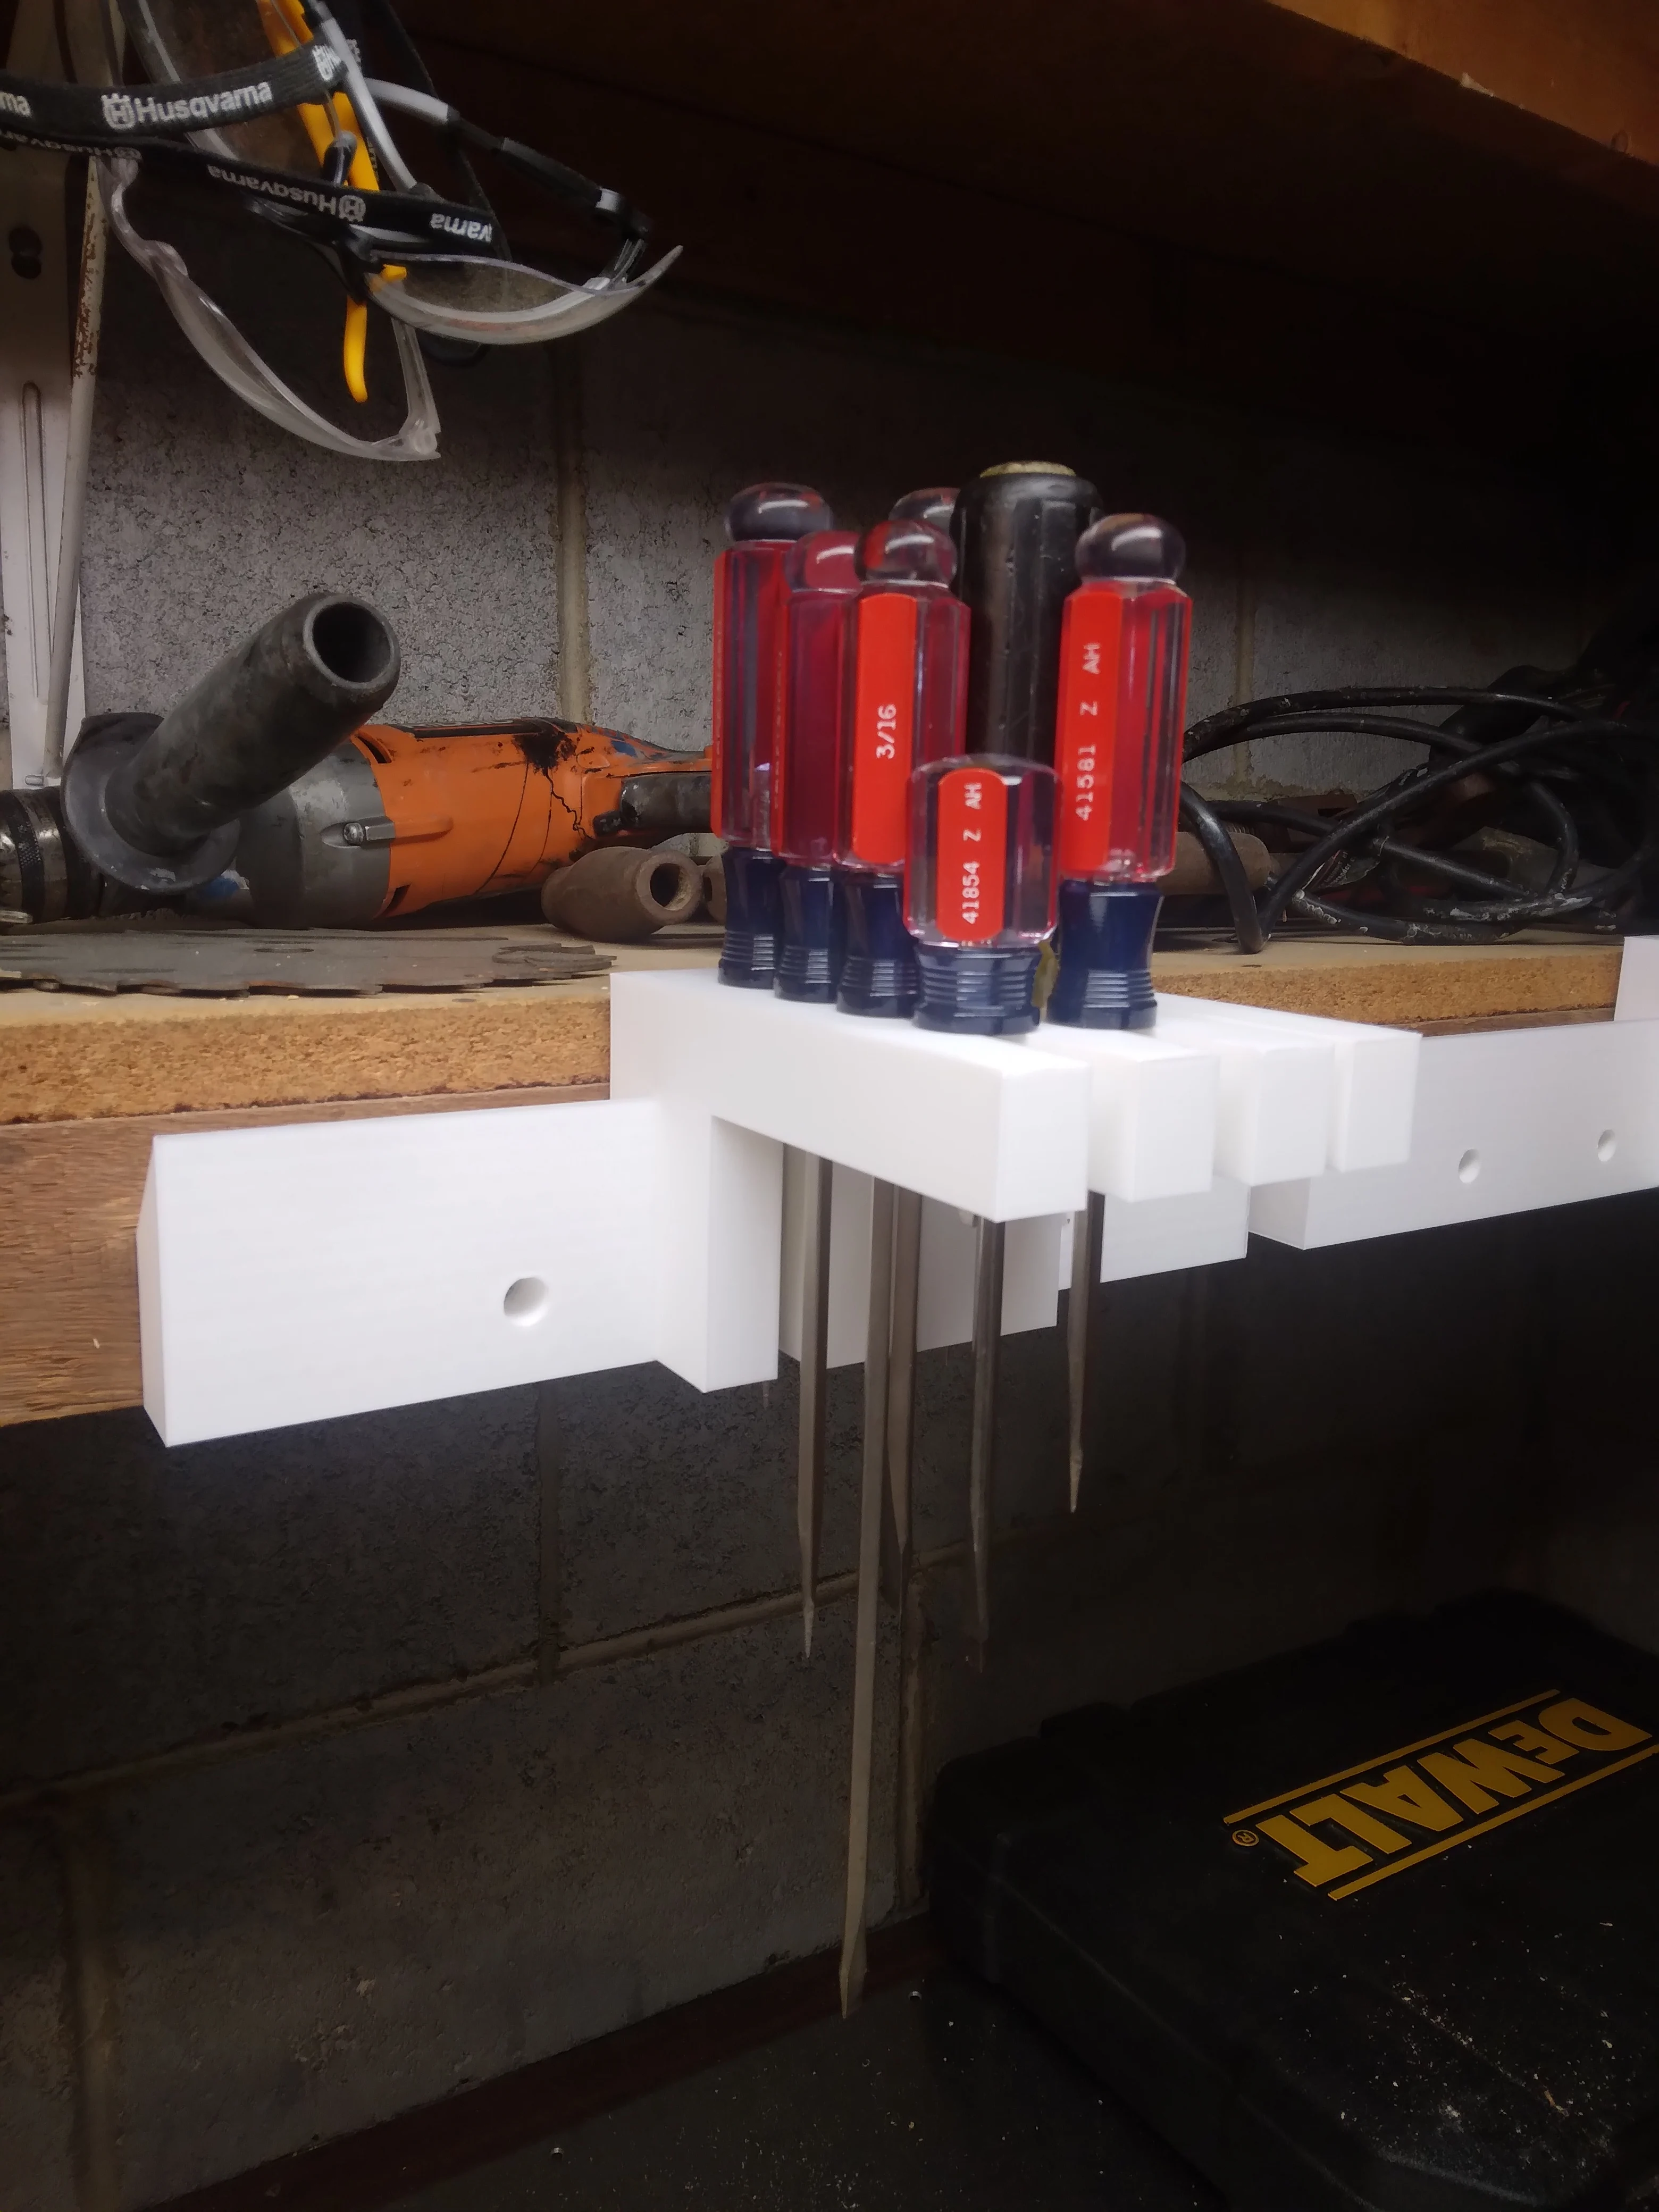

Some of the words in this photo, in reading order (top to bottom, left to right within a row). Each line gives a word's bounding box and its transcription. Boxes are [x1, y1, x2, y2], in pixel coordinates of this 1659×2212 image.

[136, 82, 273, 123] Husqvarna
[208, 163, 338, 214] Husqvarna
[876, 703, 898, 760] 3/16
[1080, 701, 1099, 716] Z
[1076, 745, 1096, 821] 41581
[963, 830, 982, 842] Z
[962, 860, 981, 925] 41854
[1256, 1698, 1652, 1887] DEWALT
